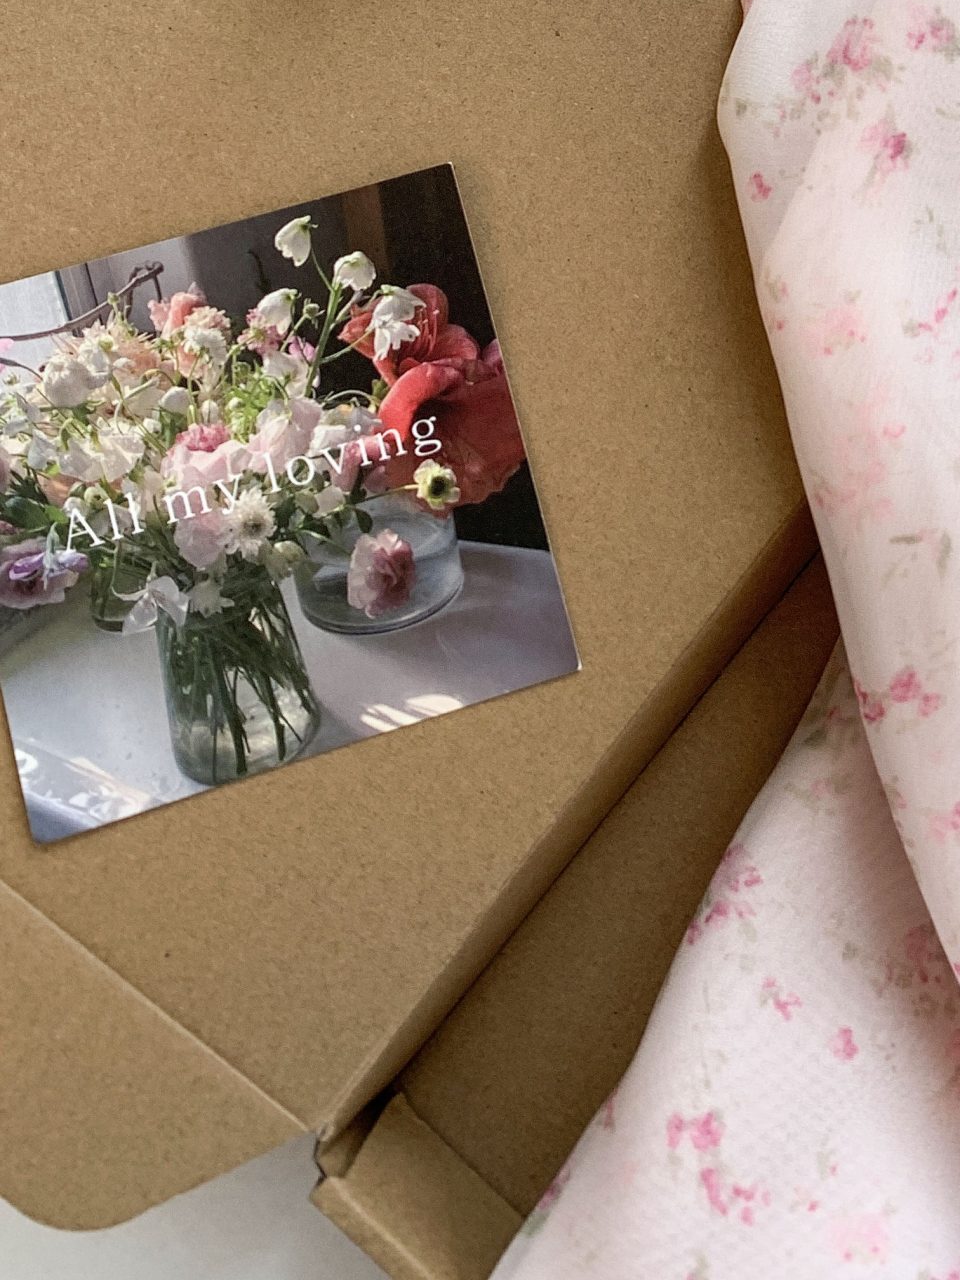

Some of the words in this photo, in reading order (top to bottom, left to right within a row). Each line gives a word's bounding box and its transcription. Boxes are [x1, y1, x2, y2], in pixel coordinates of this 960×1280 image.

[66, 492, 145, 551] All
[162, 473, 244, 525] my
[264, 415, 443, 494] loving
